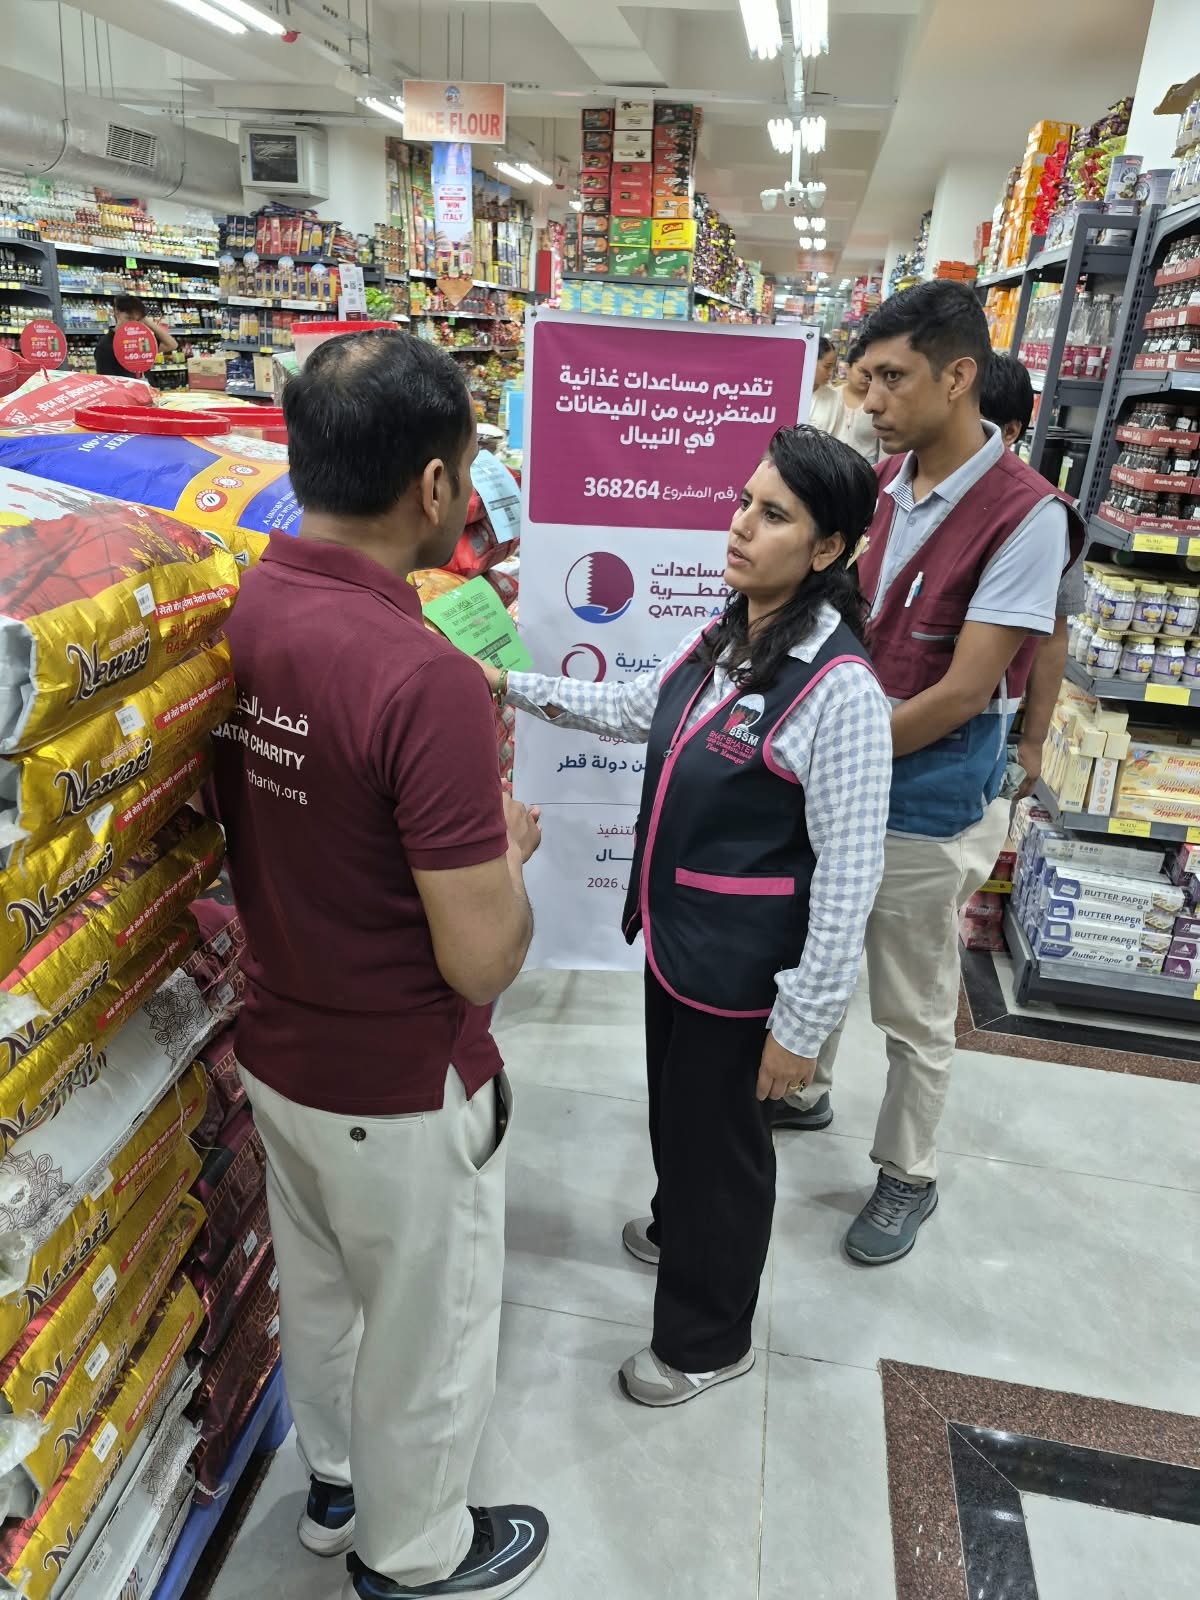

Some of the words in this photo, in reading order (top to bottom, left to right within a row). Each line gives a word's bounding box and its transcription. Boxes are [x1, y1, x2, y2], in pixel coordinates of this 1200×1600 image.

[450, 112, 500, 136] FLOUR
[560, 365, 620, 390] غذائية
[624, 372, 709, 394] مساعدات
[712, 378, 773, 400] تقديم
[556, 394, 646, 420] الفيضانات
[650, 404, 678, 421] من
[683, 404, 776, 426] للمتضررين
[620, 426, 680, 450] النيبال
[684, 427, 715, 454] في
[584, 477, 660, 500] 368264
[662, 486, 712, 500] المشروع
[714, 487, 738, 502] رقم
[648, 605, 706, 618] QATAR
[66, 628, 150, 704] Newari
[256, 706, 308, 736] قطر
[729, 727, 760, 746] BBSM
[250, 734, 305, 770] CHARITY
[556, 754, 586, 772] قطر
[592, 755, 627, 773] دولة
[53, 738, 152, 824] Newari
[1157, 784, 1186, 794] Zipper
[1187, 788, 1200, 796] Ba
[1154, 808, 1184, 818] Zipper
[587, 878, 618, 888] 2026
[7, 842, 114, 950] Newari
[1084, 888, 1119, 902] BUTTER
[1121, 895, 1150, 906] PAPER
[1078, 909, 1112, 922] BUTTER
[1114, 914, 1142, 926] PAPER
[1074, 930, 1108, 942] BUTTER
[1110, 936, 1138, 947] PAPER
[1072, 950, 1097, 961] Butter
[1098, 954, 1122, 966] Paper
[16, 1208, 109, 1322] Newari
